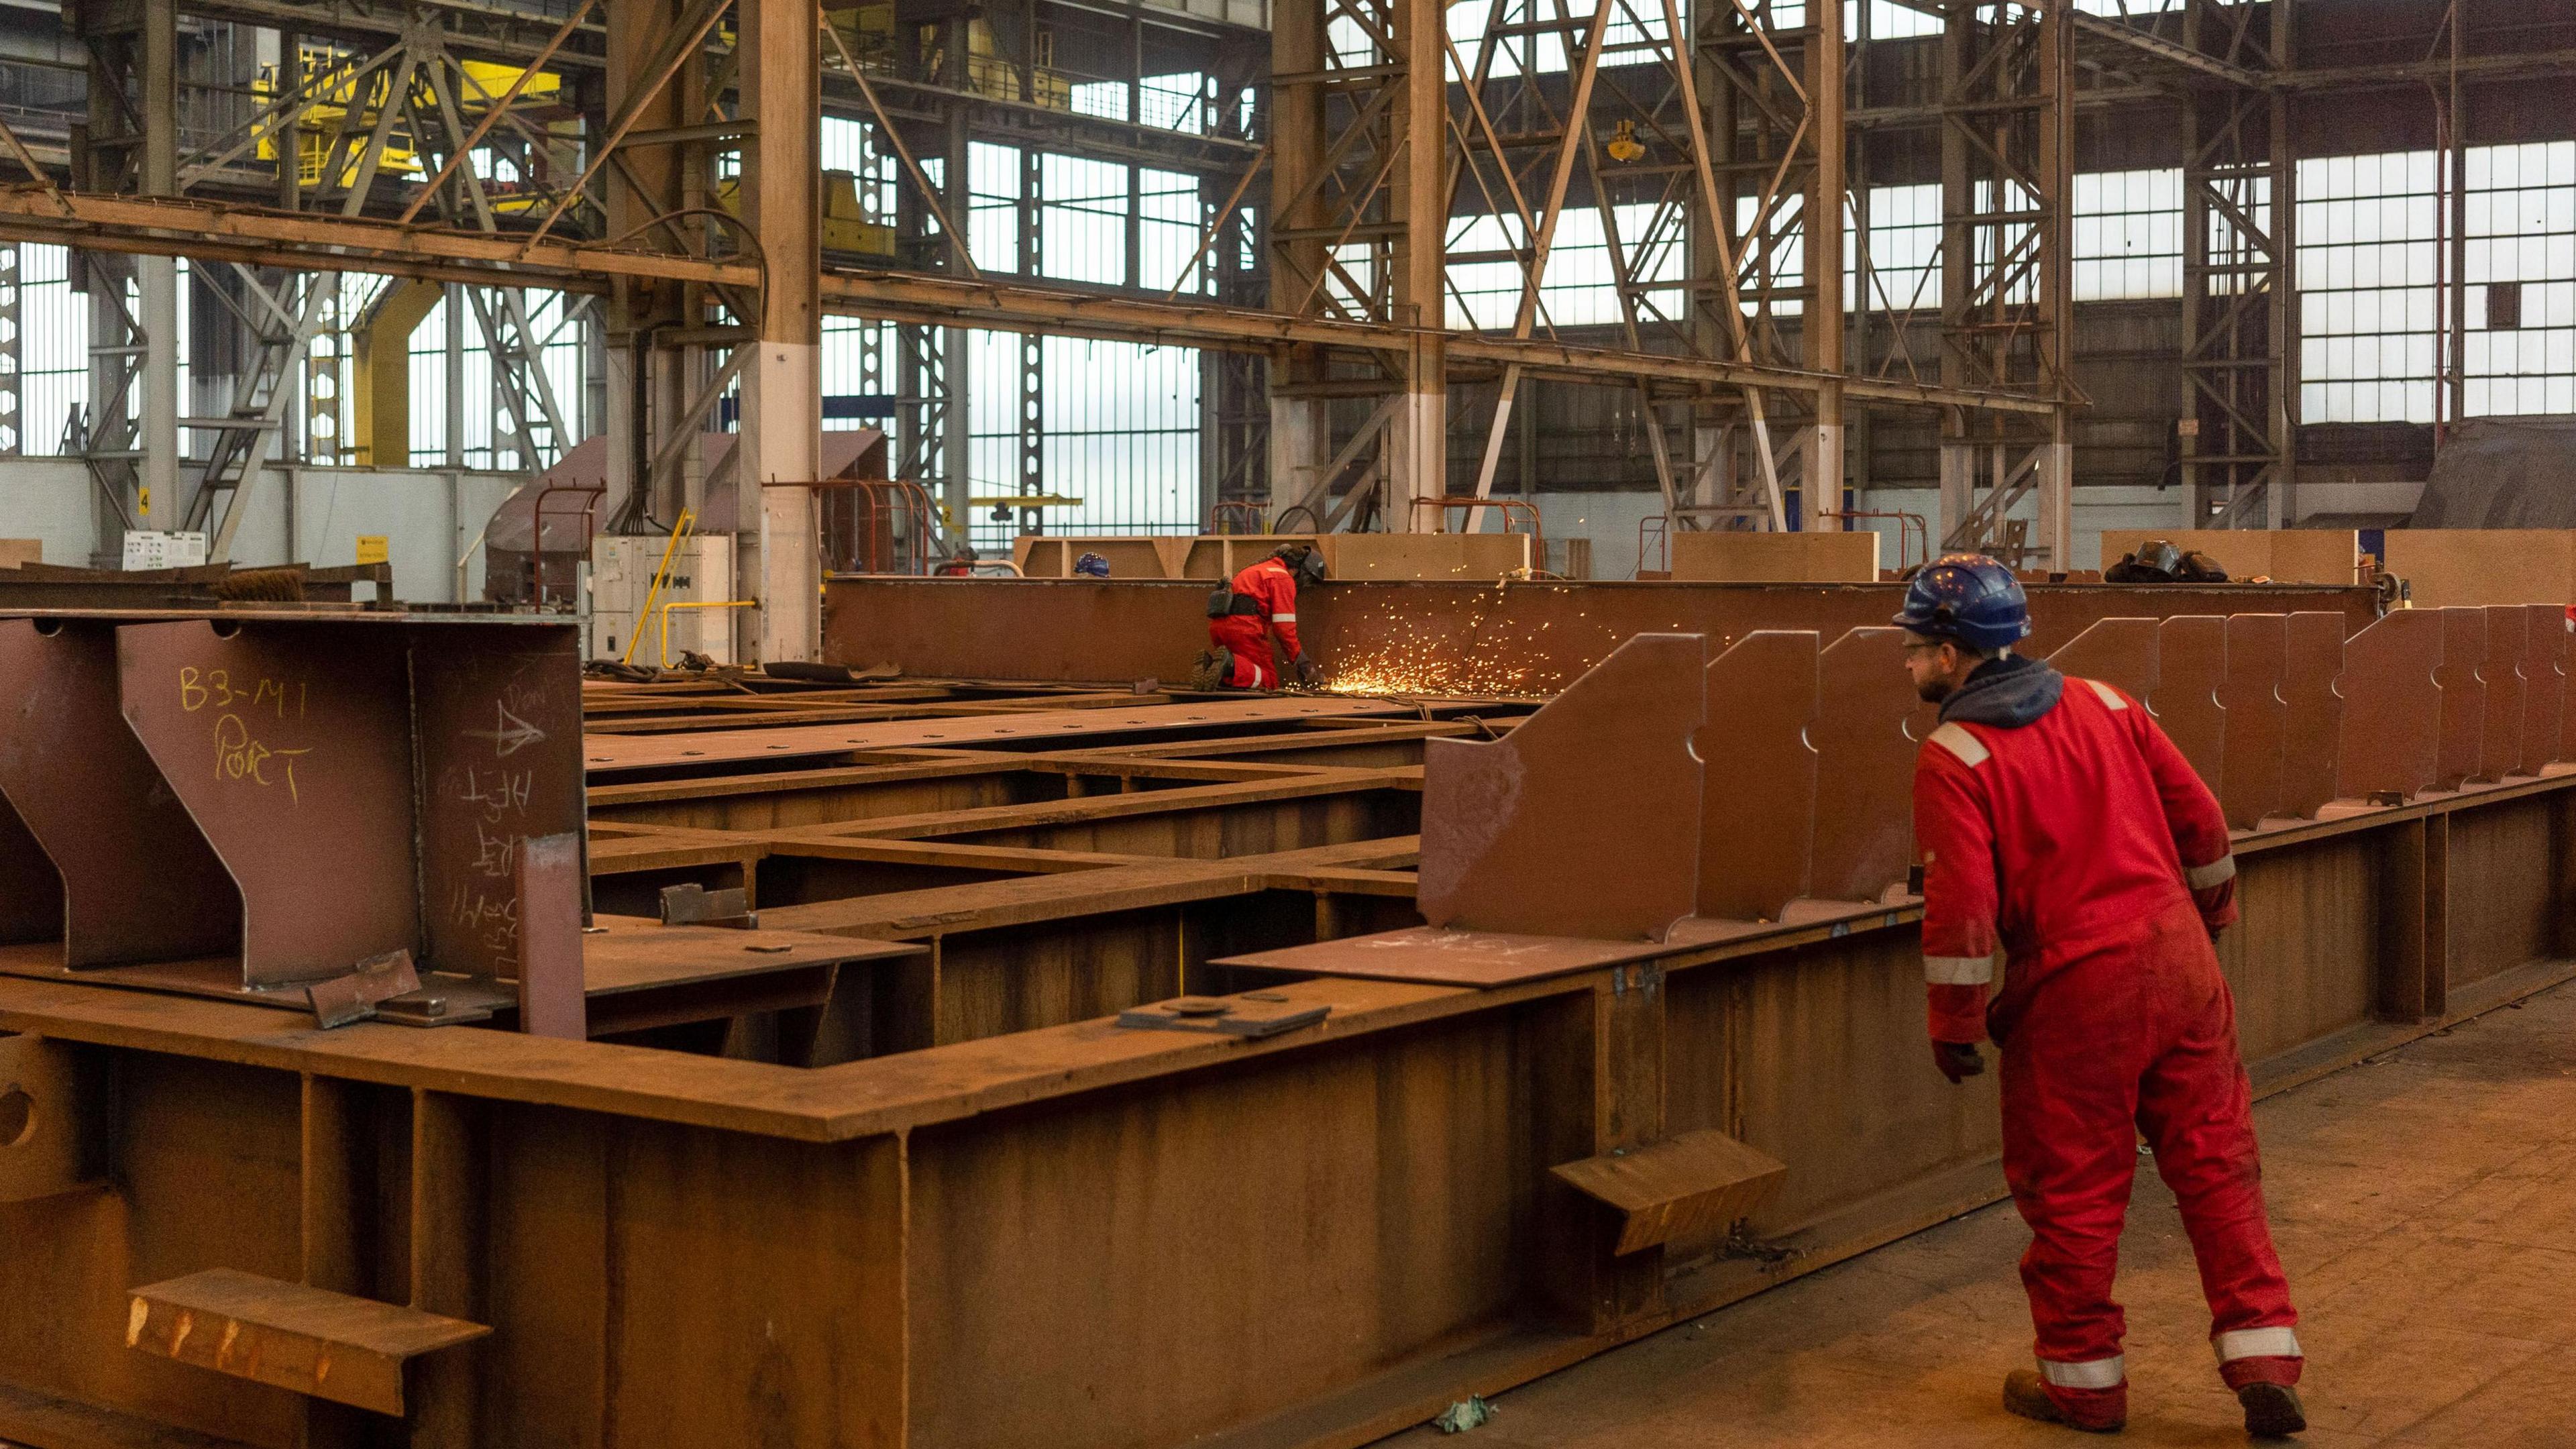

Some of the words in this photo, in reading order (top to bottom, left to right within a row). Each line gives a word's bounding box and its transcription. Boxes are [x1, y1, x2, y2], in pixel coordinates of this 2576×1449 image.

[140, 494, 148, 508] 4
[945, 511, 951, 522] 2
[215, 714, 314, 808] PORT
